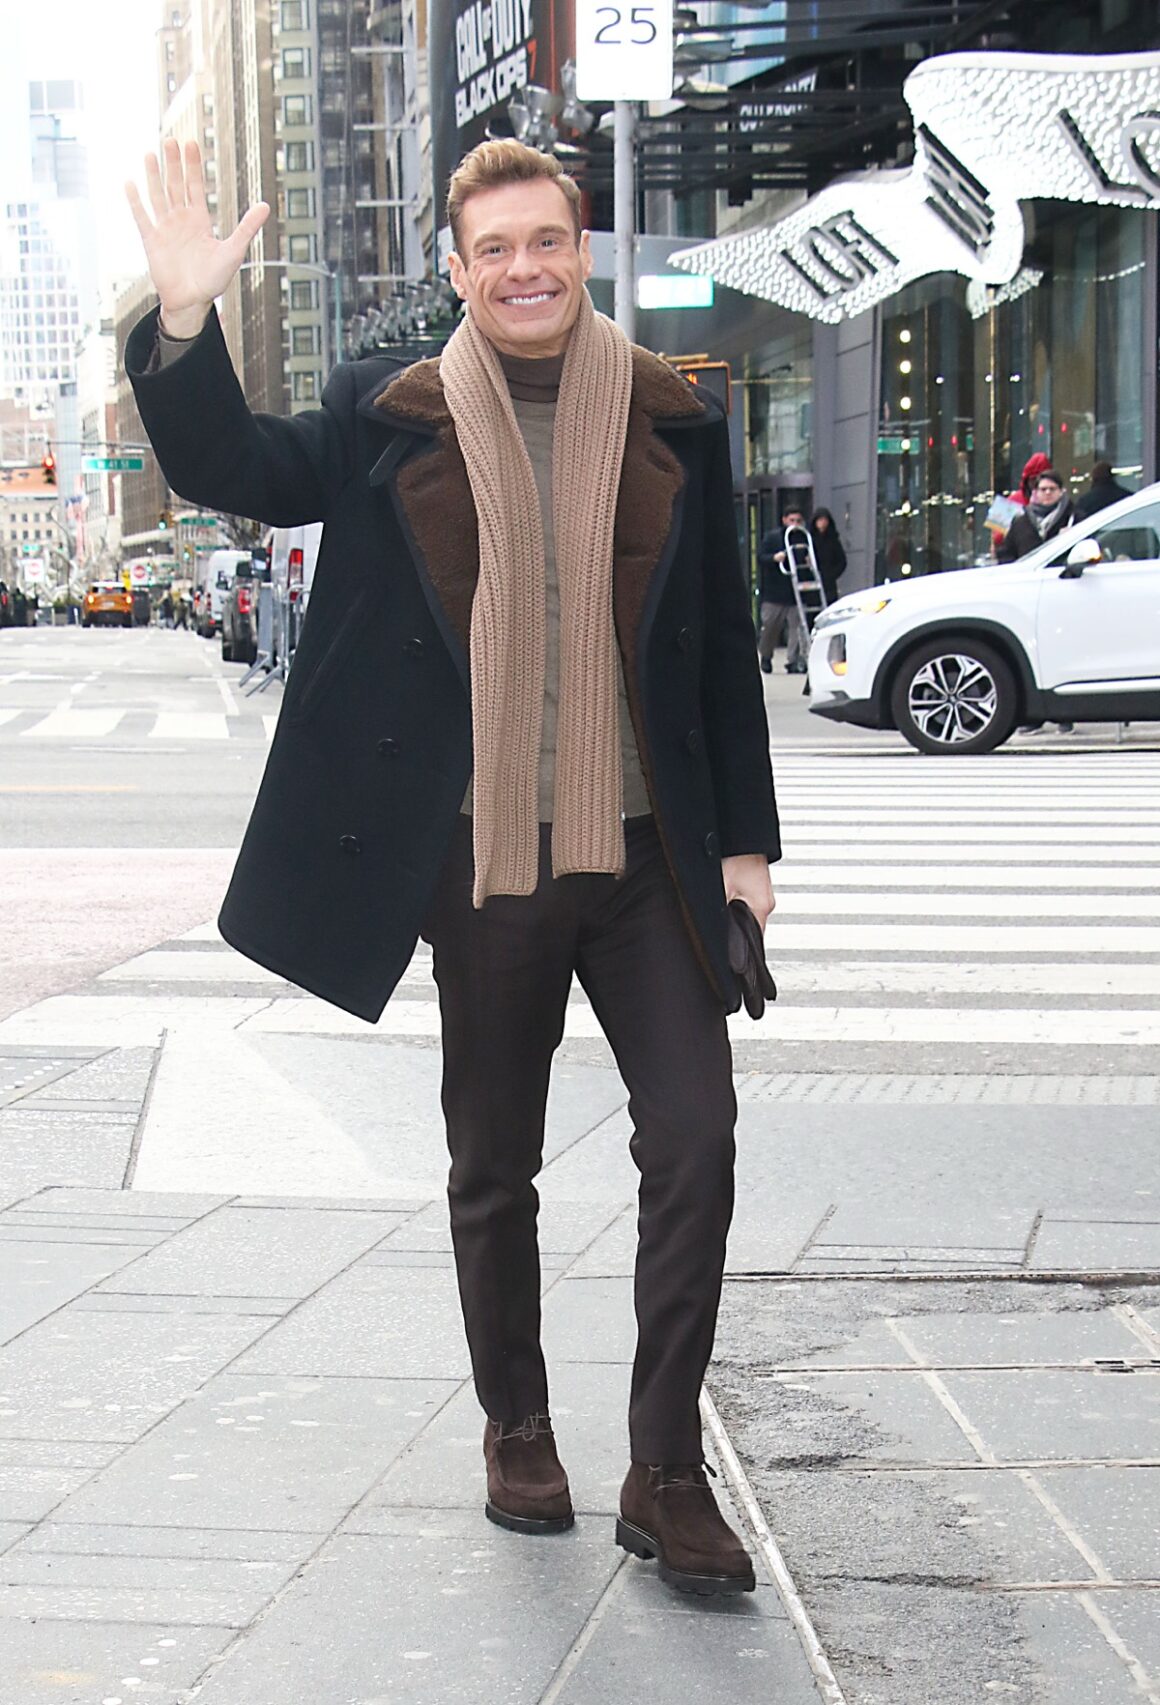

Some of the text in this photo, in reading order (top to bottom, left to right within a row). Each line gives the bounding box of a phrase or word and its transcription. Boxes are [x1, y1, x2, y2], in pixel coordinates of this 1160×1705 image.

[456, 0, 487, 84] CALL
[491, 0, 530, 60] DUTY
[594, 7, 656, 44] 25
[455, 38, 537, 128] BLACK OPS 7
